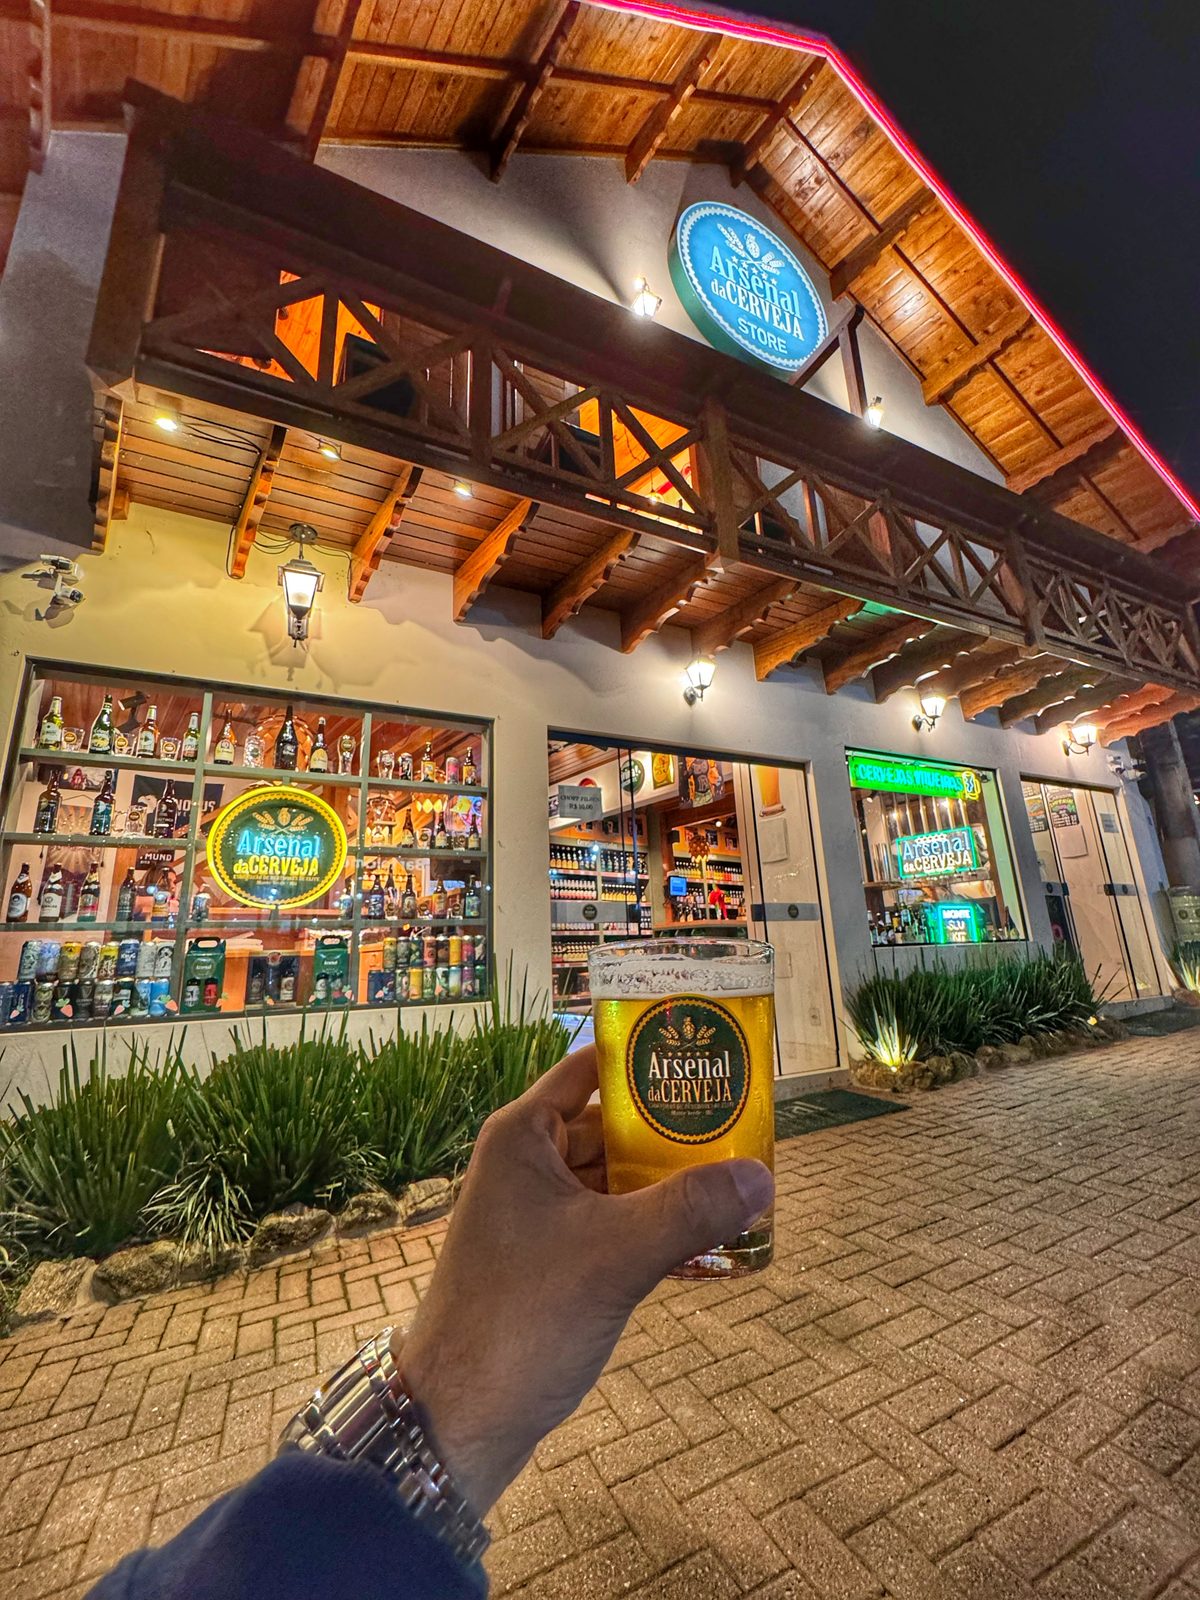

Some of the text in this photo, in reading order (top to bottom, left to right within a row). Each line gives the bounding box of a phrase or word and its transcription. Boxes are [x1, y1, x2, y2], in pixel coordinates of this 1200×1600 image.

[709, 245, 802, 319] Arsenal
[737, 317, 788, 354] STORE
[236, 829, 321, 858] Arsenal
[903, 831, 970, 860] Arsenal
[648, 1050, 732, 1079] Arsenal
